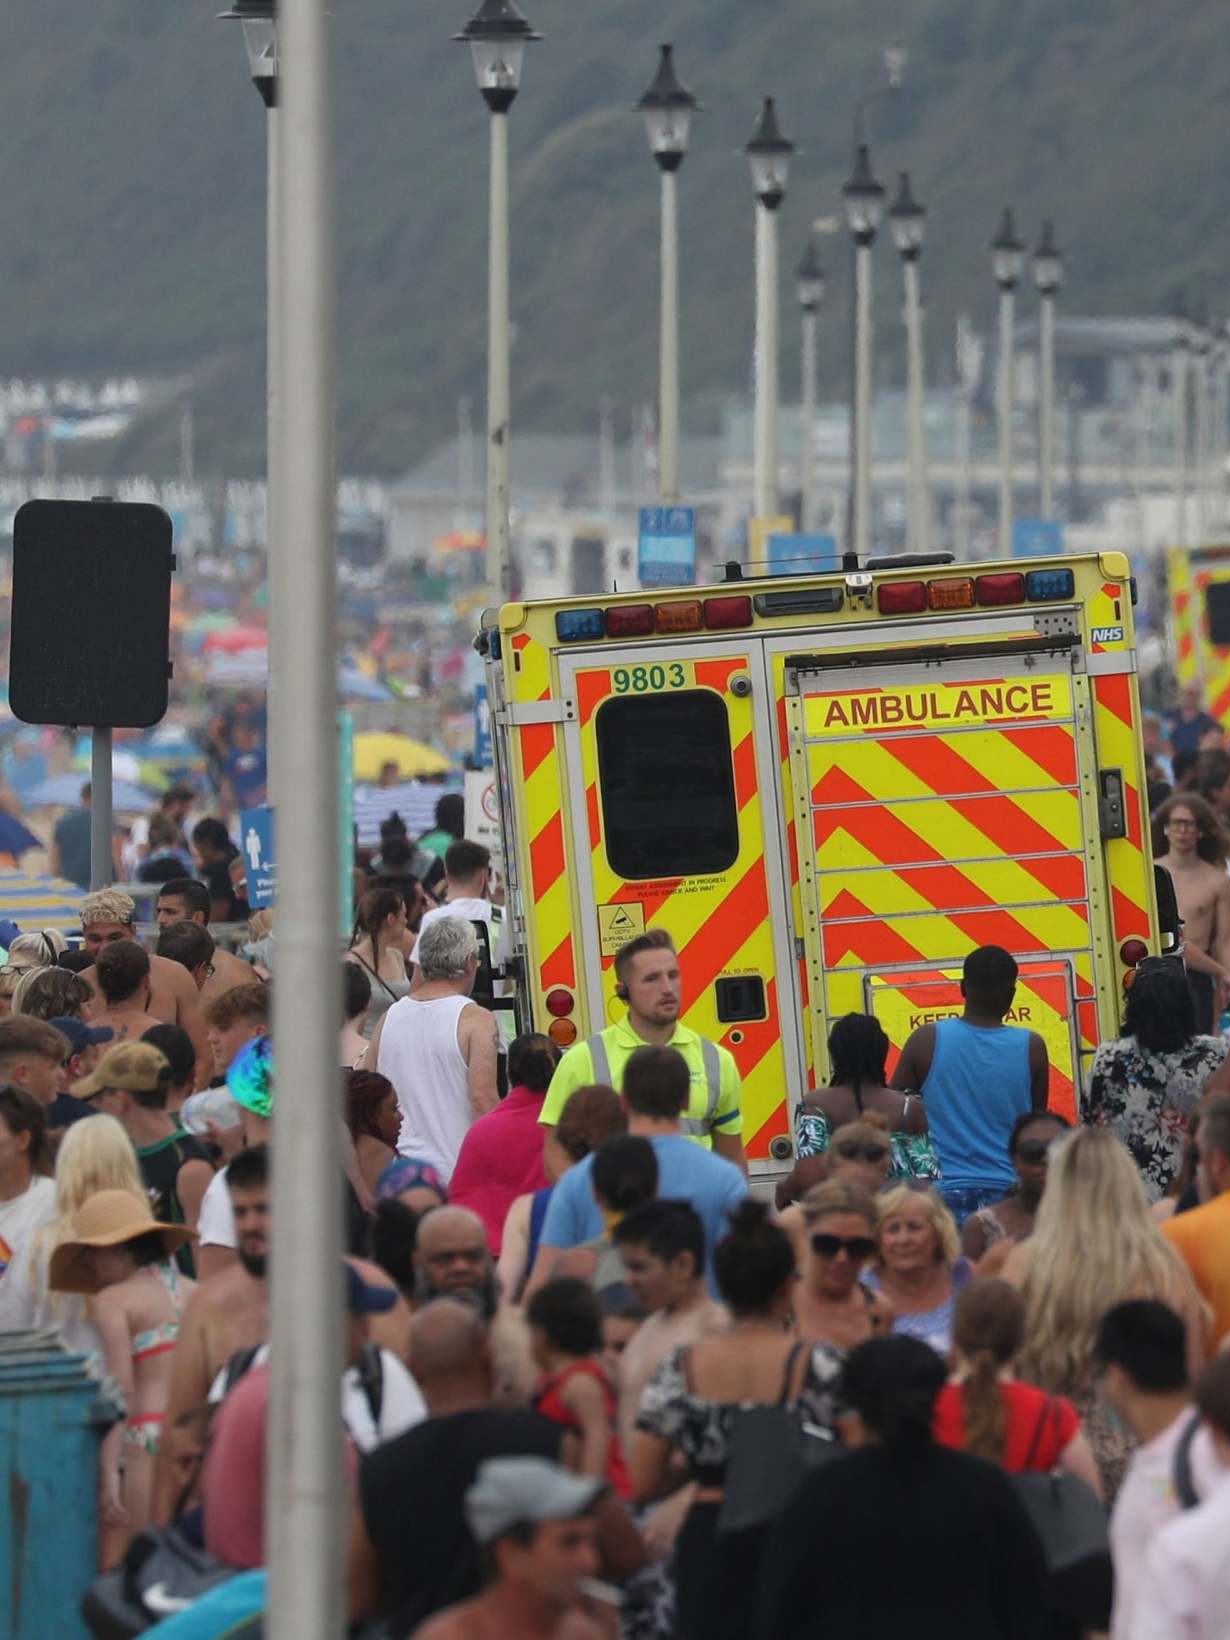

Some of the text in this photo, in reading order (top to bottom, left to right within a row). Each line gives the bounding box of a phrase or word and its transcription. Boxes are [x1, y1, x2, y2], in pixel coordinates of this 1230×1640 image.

[1092, 628, 1122, 642] NHS
[613, 663, 685, 694] 9803
[824, 683, 1054, 728] AMBULANCE
[685, 886, 698, 894] AND
